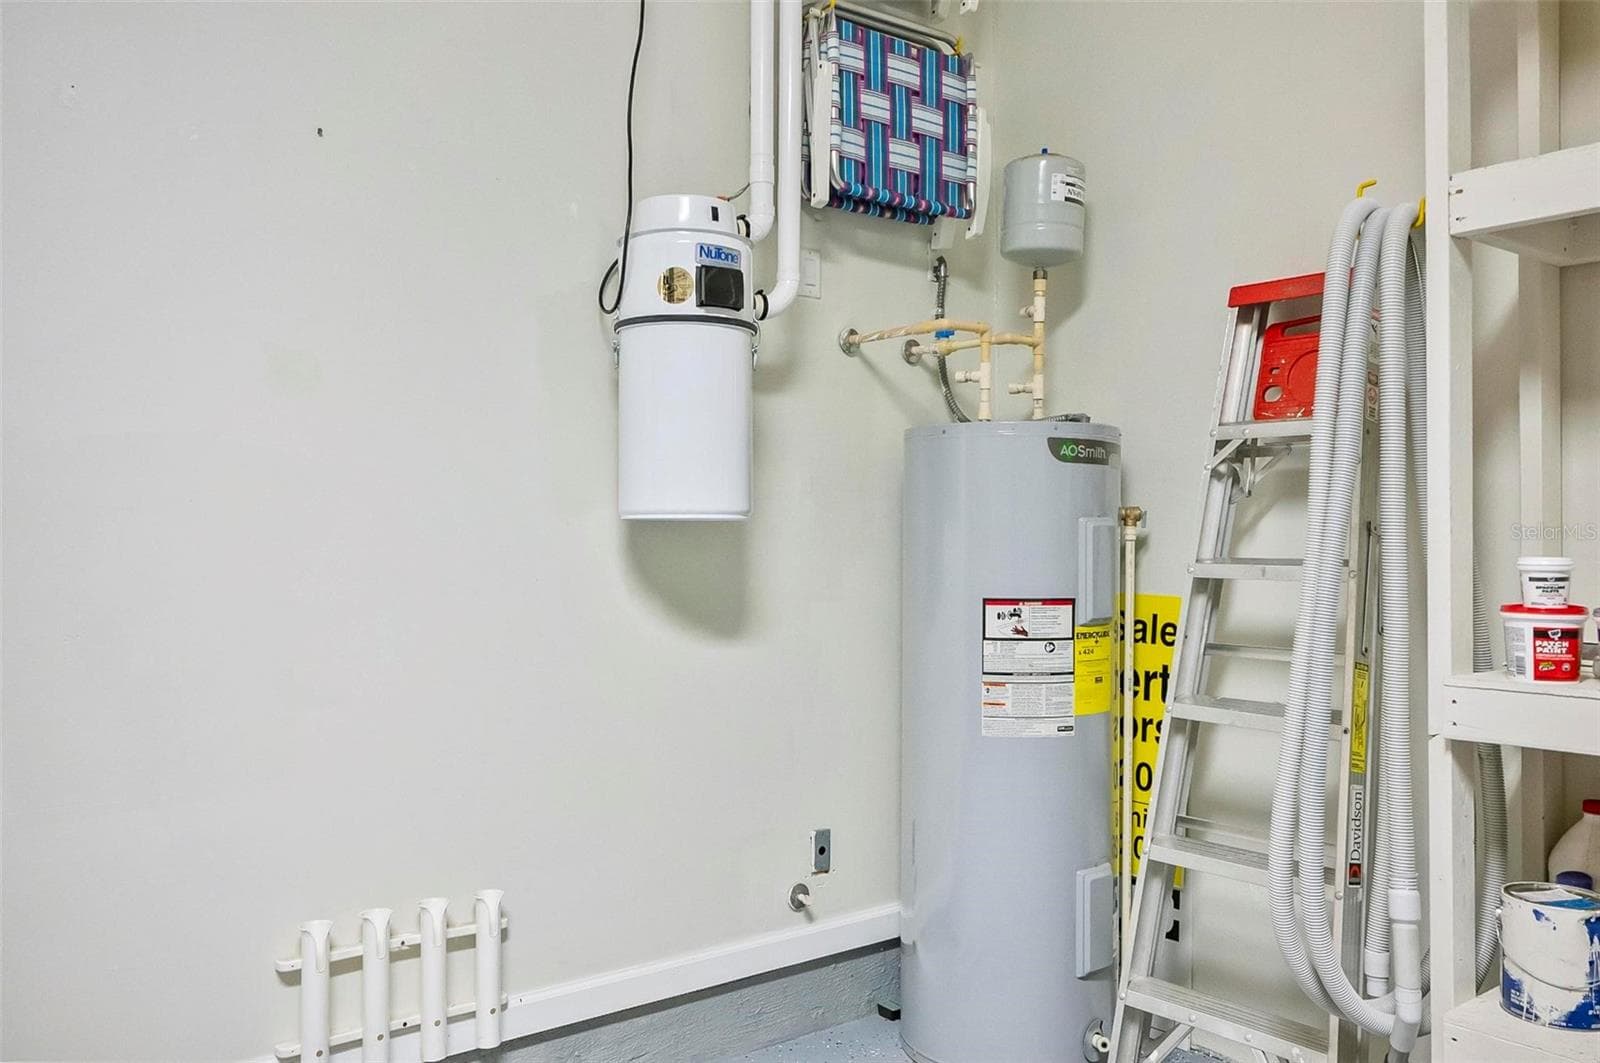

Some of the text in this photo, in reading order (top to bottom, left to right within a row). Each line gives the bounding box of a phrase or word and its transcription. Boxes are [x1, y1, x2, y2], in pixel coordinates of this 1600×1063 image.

[700, 245, 739, 264] NuTone
[1120, 610, 1177, 647] ale
[1350, 791, 1363, 862] Davidson
